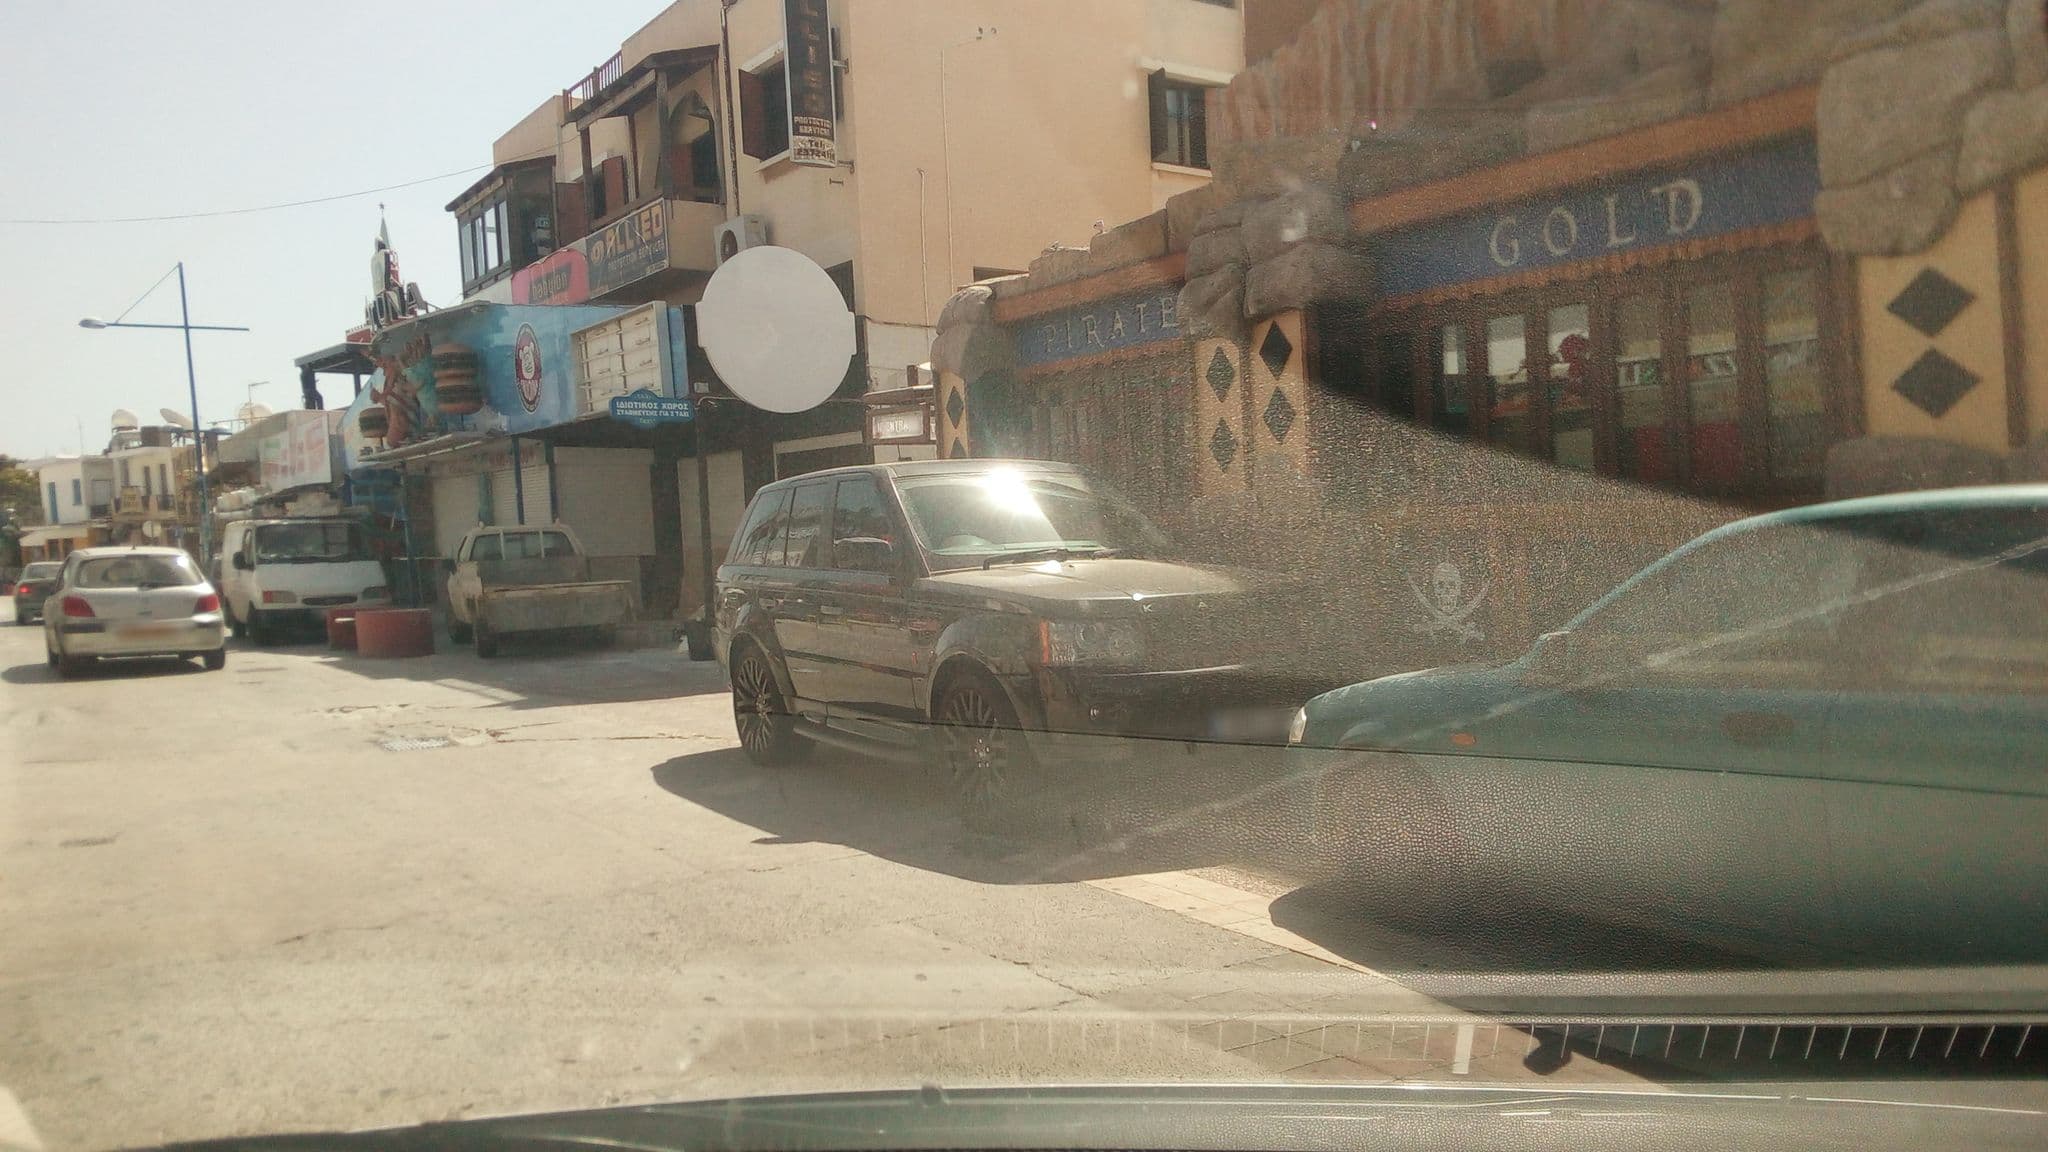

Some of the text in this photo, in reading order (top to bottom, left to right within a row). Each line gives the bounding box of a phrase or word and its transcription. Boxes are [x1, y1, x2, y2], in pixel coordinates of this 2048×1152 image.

[1489, 179, 1703, 267] GOLD
[1043, 297, 1178, 353] PIRATE
[616, 401, 689, 411] ΙΔΙΩΤΙΚΟΣ ΧΩΡΟΣ
